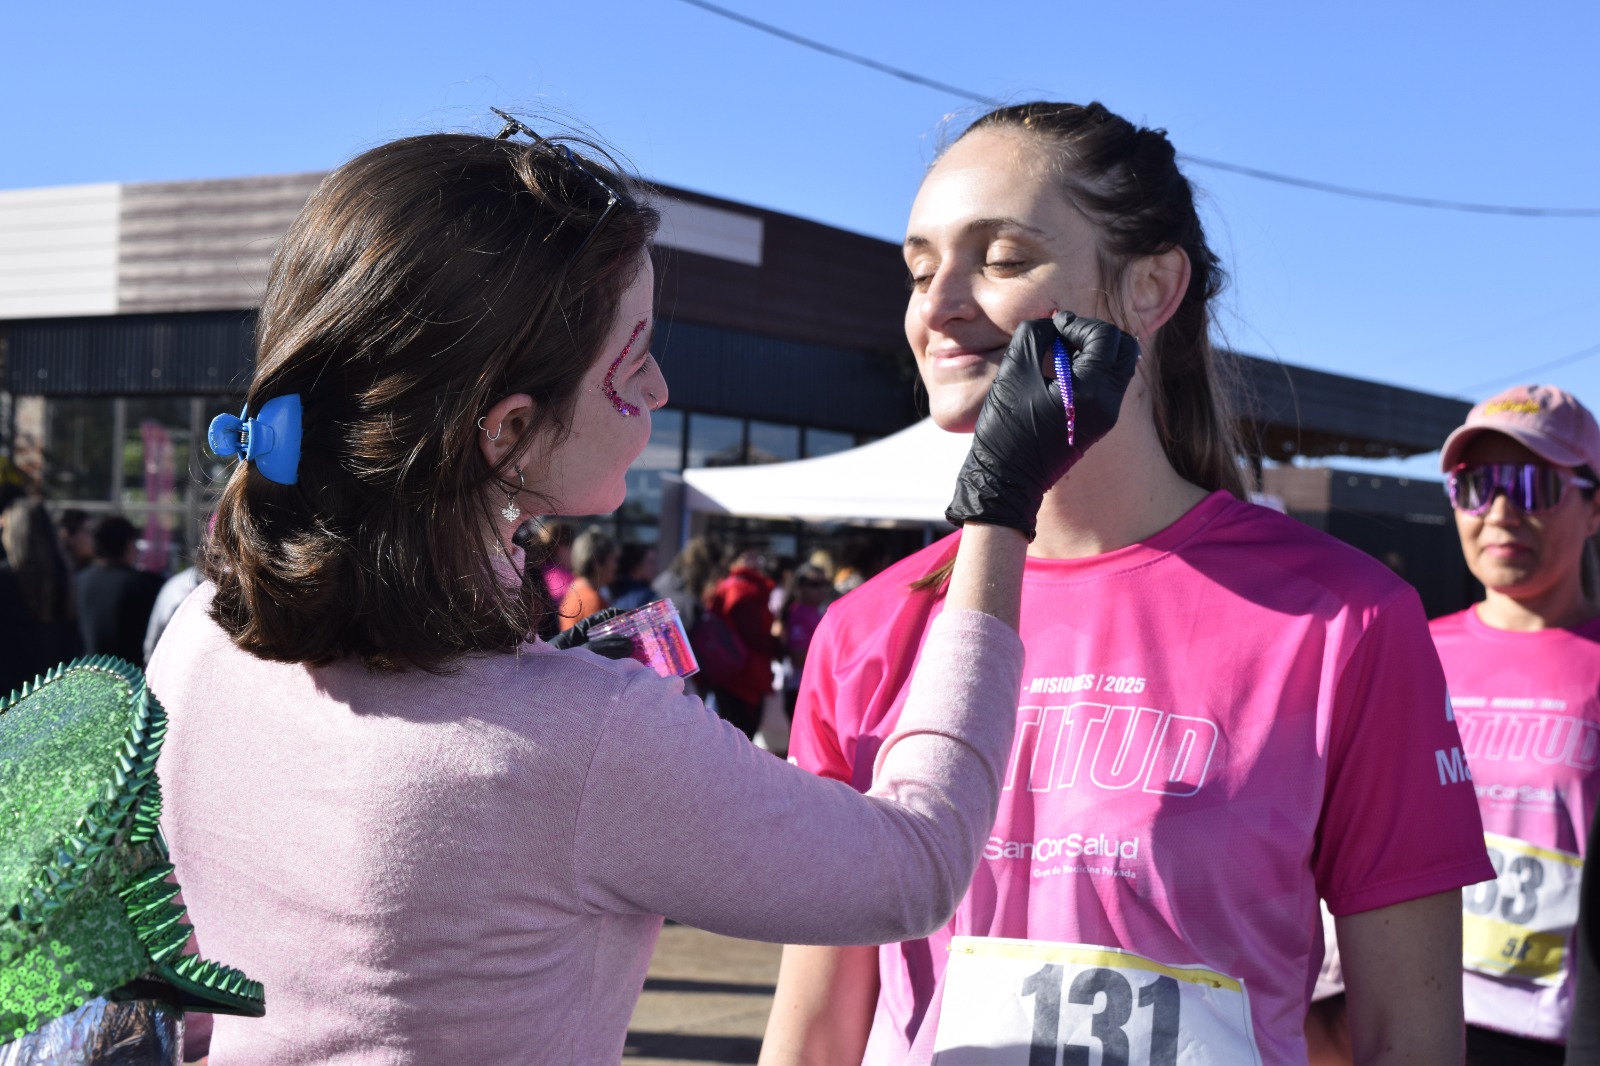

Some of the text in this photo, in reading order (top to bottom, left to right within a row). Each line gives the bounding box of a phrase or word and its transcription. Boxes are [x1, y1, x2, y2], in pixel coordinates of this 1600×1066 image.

[1029, 674, 1095, 694] MISIONES
[1103, 675, 1147, 694] 2025
[982, 832, 1139, 862] SanCorSalud
[1021, 963, 1182, 1066] 131
